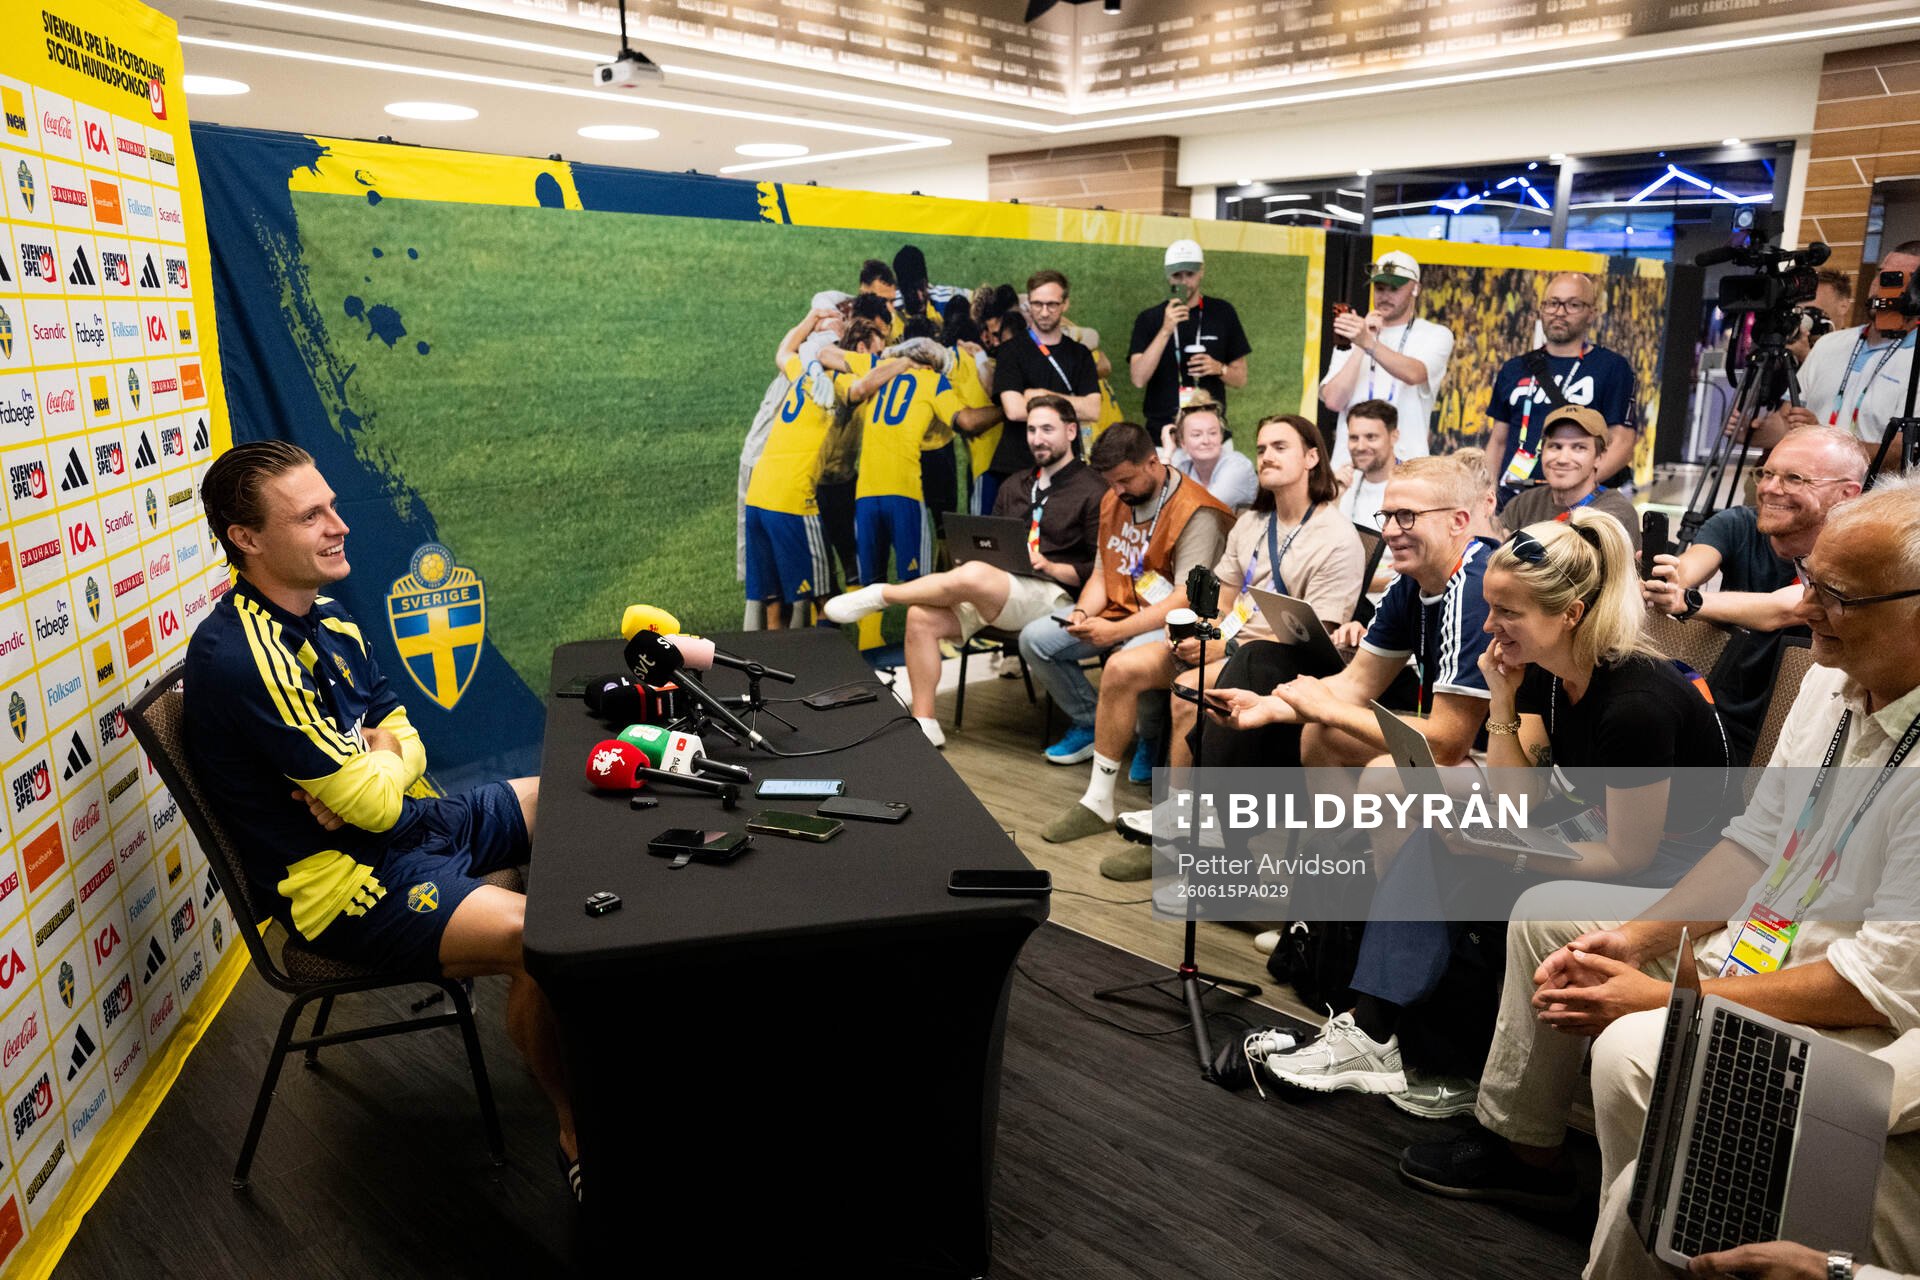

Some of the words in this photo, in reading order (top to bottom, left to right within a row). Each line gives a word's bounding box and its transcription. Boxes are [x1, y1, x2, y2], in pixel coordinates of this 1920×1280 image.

[42, 10, 84, 49] SVENSKA
[84, 30, 105, 59] SPEL
[105, 36, 118, 64] ÄR
[118, 46, 166, 85] FOTBOLLENS
[46, 38, 81, 72] STOLTA
[81, 53, 151, 101] HUVUDSPONSOR
[84, 120, 111, 155] ICA
[117, 138, 146, 157] BAUHAUS
[52, 186, 87, 205] BAUHAUS
[158, 207, 181, 224] Scandic
[21, 243, 54, 261] SVENSKA
[23, 260, 42, 277] SPEL
[104, 266, 119, 281] SPEL
[33, 323, 67, 340] Scandic
[75, 322, 105, 347] Fabege
[146, 315, 168, 342] ICA
[152, 378, 177, 394] BAUHAUS
[872, 373, 917, 425] 10
[0, 401, 35, 426] Fabege
[95, 441, 122, 461] SVENSKA
[10, 460, 45, 483] SVENSKA
[97, 459, 113, 475] SPEL
[12, 480, 32, 500] SPEL
[105, 510, 134, 534] Scandic
[68, 521, 97, 556] ICA
[20, 540, 61, 567] BAUHAUS
[114, 572, 145, 597] BAUHAUS
[184, 594, 208, 618] Scandic
[401, 588, 471, 611] SVERIGE
[35, 614, 70, 641] Fabege
[158, 608, 179, 641] ICA
[0, 632, 25, 656] andic
[633, 653, 656, 680] svt
[47, 676, 82, 707] Folksam
[101, 727, 117, 747] SPEL
[1815, 767, 1828, 788] FIFA
[1823, 731, 1841, 766] WORLD
[1838, 711, 1848, 731] CUP
[1893, 728, 1920, 762] WORLD
[13, 759, 49, 798] SVENSKA
[15, 788, 35, 813] SPEL
[153, 803, 178, 833] Fabege
[120, 830, 147, 864] Scandic
[79, 860, 115, 902] BAUHAUS
[128, 886, 157, 924] Folksam
[94, 922, 121, 967] ICA
[172, 922, 186, 944] SPEL
[0, 947, 26, 989] CA
[179, 959, 203, 996] Fabege
[102, 973, 131, 1016] SVENSKA
[104, 1002, 121, 1029] SPEL
[113, 1039, 142, 1084] Scandic
[13, 1071, 50, 1126] SVENSKA
[15, 1110, 37, 1142] SPEL
[71, 1088, 107, 1140] Folksam
